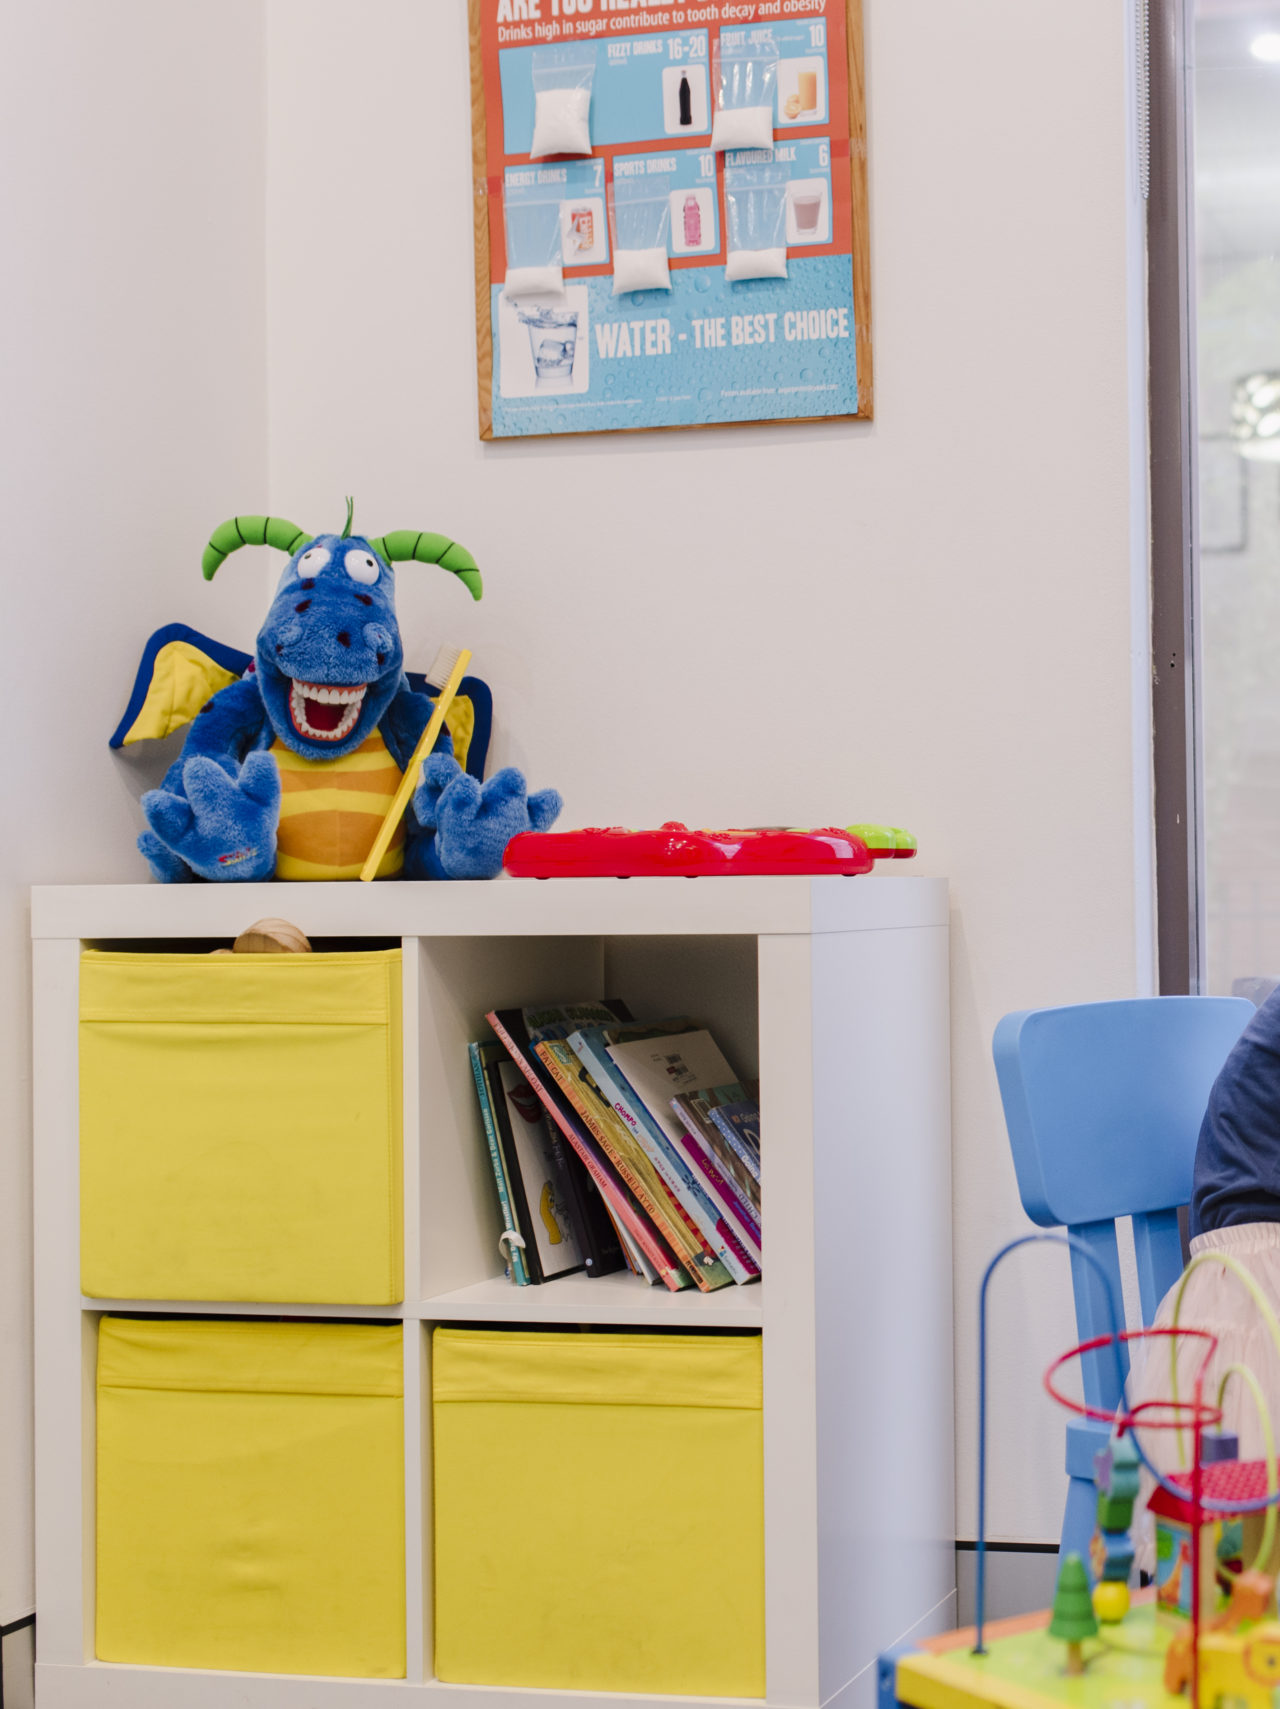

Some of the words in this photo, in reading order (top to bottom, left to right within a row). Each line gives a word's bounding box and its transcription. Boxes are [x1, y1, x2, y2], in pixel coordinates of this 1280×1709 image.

[498, 26, 532, 42] Drinks
[535, 22, 559, 40] high
[562, 20, 574, 35] in
[576, 18, 607, 36] sugar
[610, 11, 669, 30] contribute
[672, 11, 685, 23] to
[688, 7, 719, 21] tooth
[721, 3, 755, 19] decay
[758, 1, 781, 15] and
[783, 0, 826, 13] obesity
[720, 31, 746, 47] FRUIT
[748, 28, 774, 44] JUICE
[808, 24, 825, 47] 10
[607, 42, 632, 58] FIZZY
[633, 39, 663, 55] DRINKS
[667, 35, 706, 60] 16-20
[614, 160, 645, 177] SPORTS
[647, 157, 677, 174] DRINKS
[698, 154, 714, 177] 10
[725, 150, 773, 167] FLAVOURED
[775, 146, 797, 162] MILK
[818, 144, 829, 167] 6
[505, 171, 536, 187] ENERGY
[537, 167, 567, 184] DRINKS
[593, 164, 603, 188] 7
[595, 318, 672, 359] WATER
[692, 317, 726, 348] THE
[731, 313, 778, 346] BEST
[784, 307, 850, 341] CHOICE
[614, 1102, 637, 1126] CHOMPO
[538, 1050, 553, 1067] FAT
[549, 1065, 564, 1082] CAT
[579, 1109, 602, 1136] JAMES
[597, 1134, 616, 1155] SAGE
[614, 1158, 641, 1192] RUSSELL
[637, 1192, 656, 1214] AYTO
[585, 1160, 608, 1188] GRAHAM
